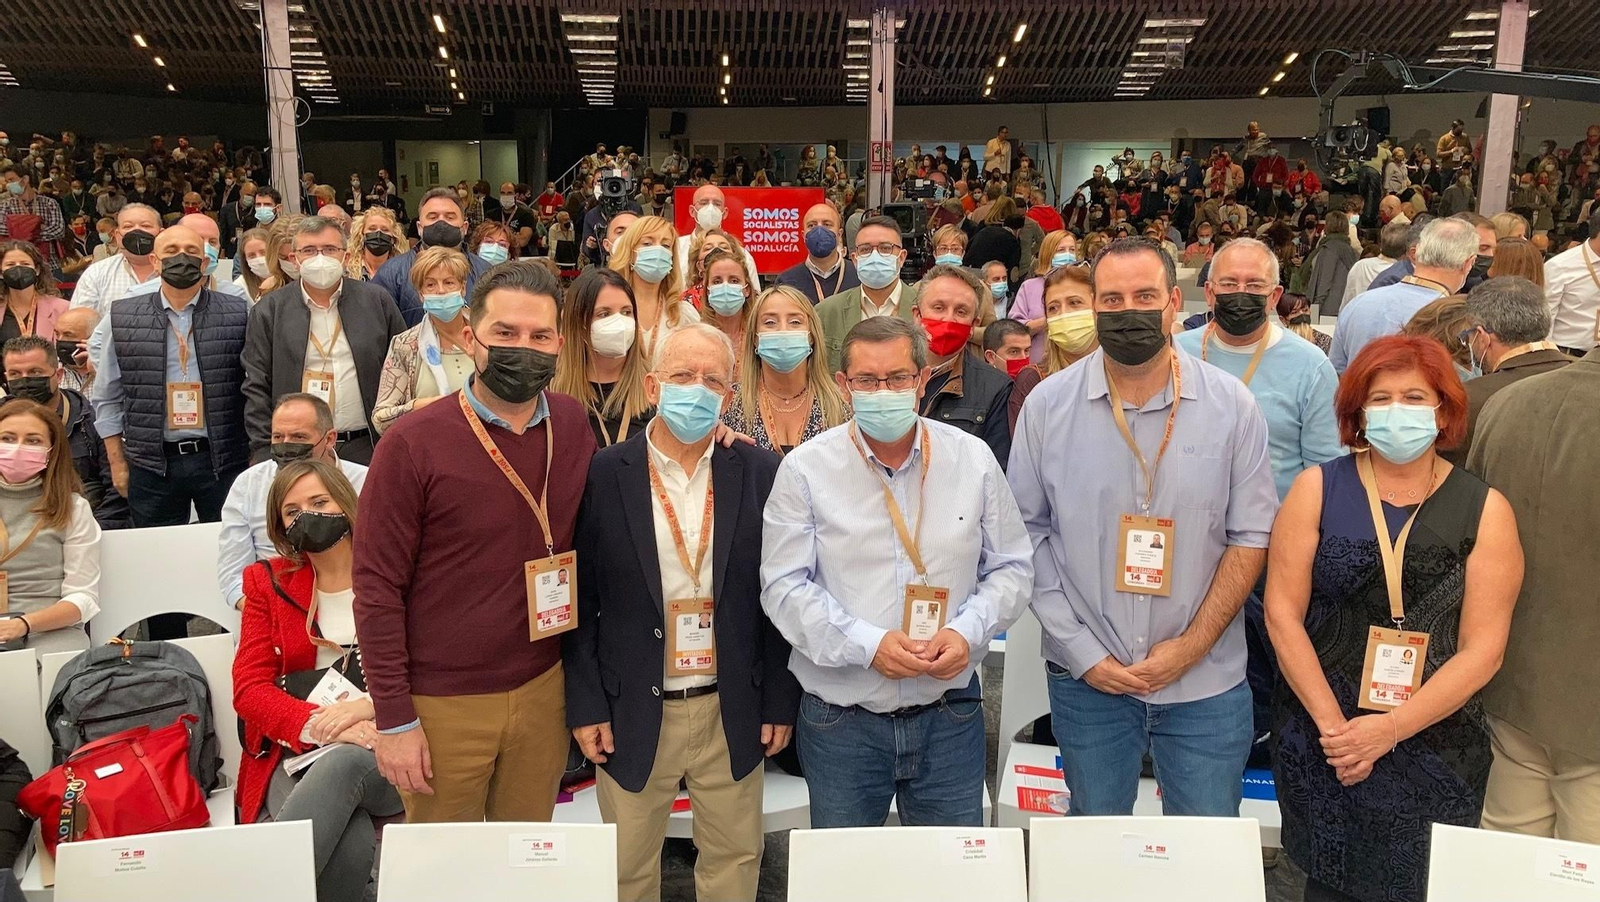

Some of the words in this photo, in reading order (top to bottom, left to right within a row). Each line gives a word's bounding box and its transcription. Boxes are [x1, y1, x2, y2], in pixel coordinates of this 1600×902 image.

[743, 208, 799, 220] SOMOS
[743, 221, 799, 229] SOCIALISTAS
[743, 231, 799, 243] SOMOS
[745, 243, 799, 252] ANDALUCÍA
[496, 457, 512, 475] PSOE
[664, 501, 675, 519] PSOE
[704, 499, 713, 515] PSOE
[1130, 573, 1141, 581] 14
[542, 617, 552, 627] 14
[680, 658, 691, 666] 14
[1375, 690, 1387, 698] 14
